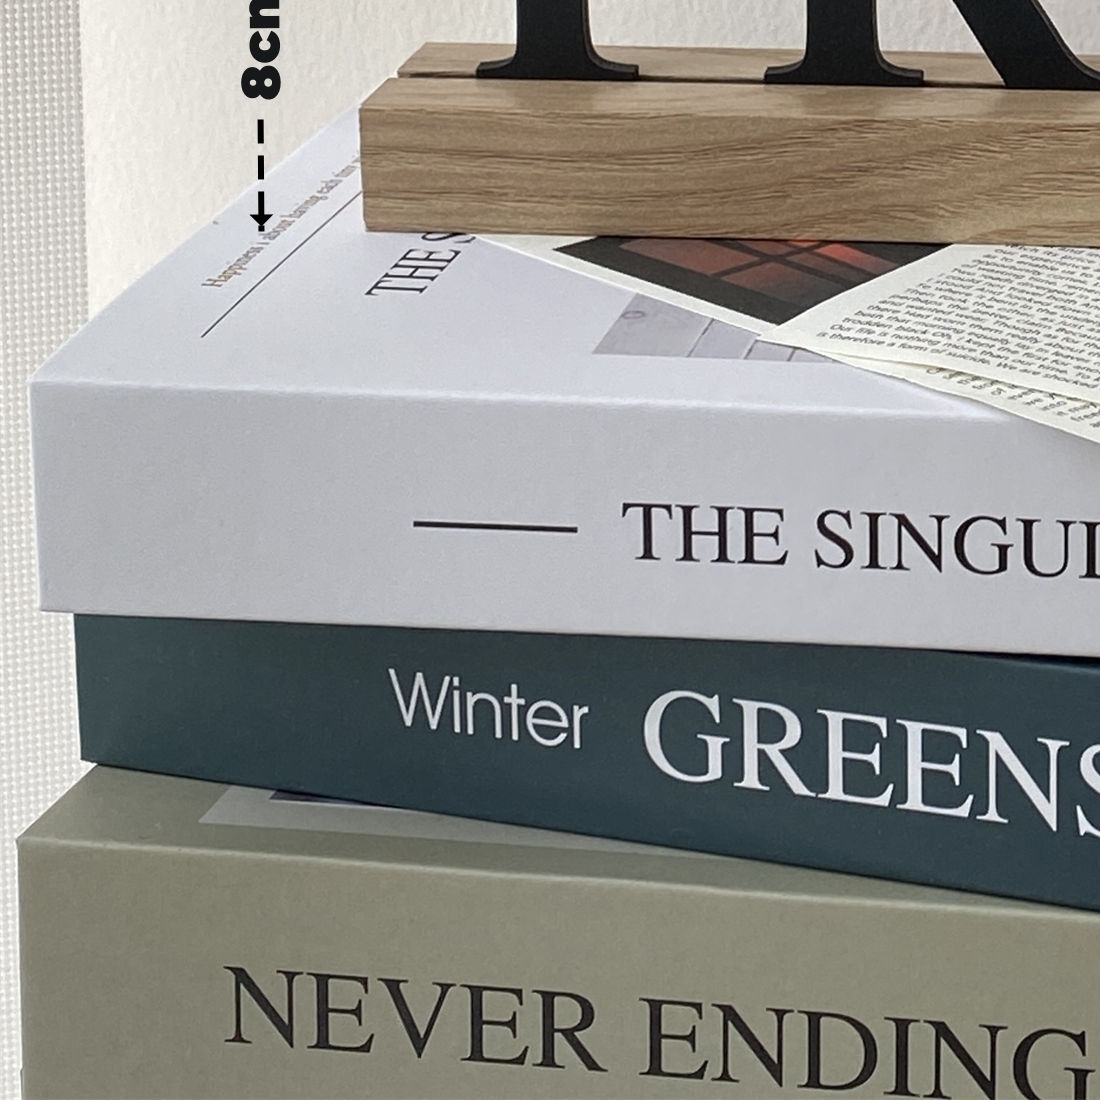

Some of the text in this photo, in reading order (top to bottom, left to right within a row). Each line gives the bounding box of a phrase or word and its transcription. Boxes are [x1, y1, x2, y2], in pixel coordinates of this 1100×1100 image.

[365, 248, 462, 296] THE
[621, 502, 789, 566] THE
[388, 668, 589, 749] Winter
[224, 965, 608, 1073] NEVER
[638, 997, 1096, 1100] ENDING
